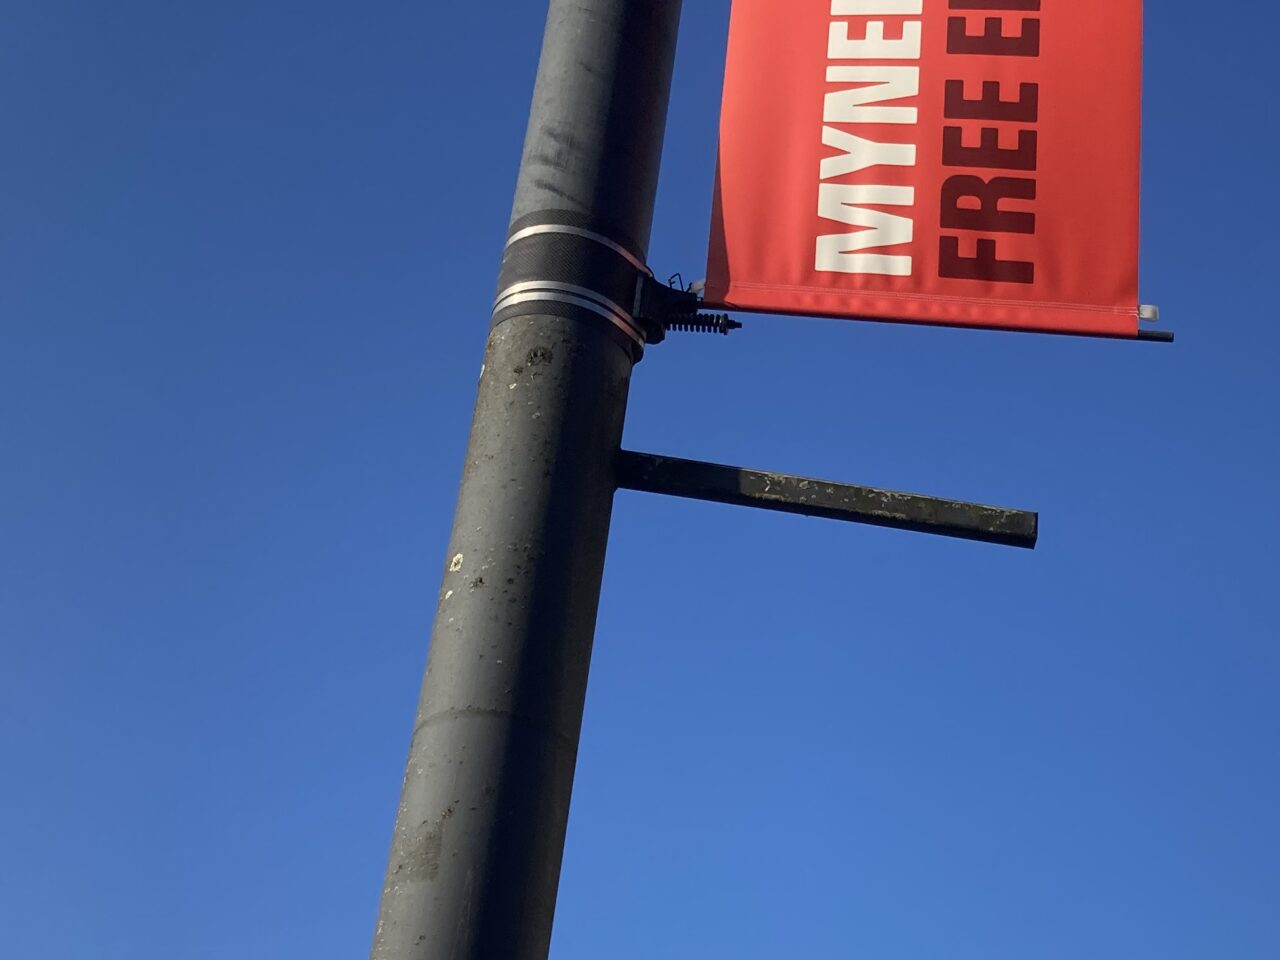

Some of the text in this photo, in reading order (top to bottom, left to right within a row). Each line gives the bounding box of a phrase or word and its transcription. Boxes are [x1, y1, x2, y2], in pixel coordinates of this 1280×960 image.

[815, 0, 923, 276] MYNE
[938, 0, 1041, 284] FREE E
